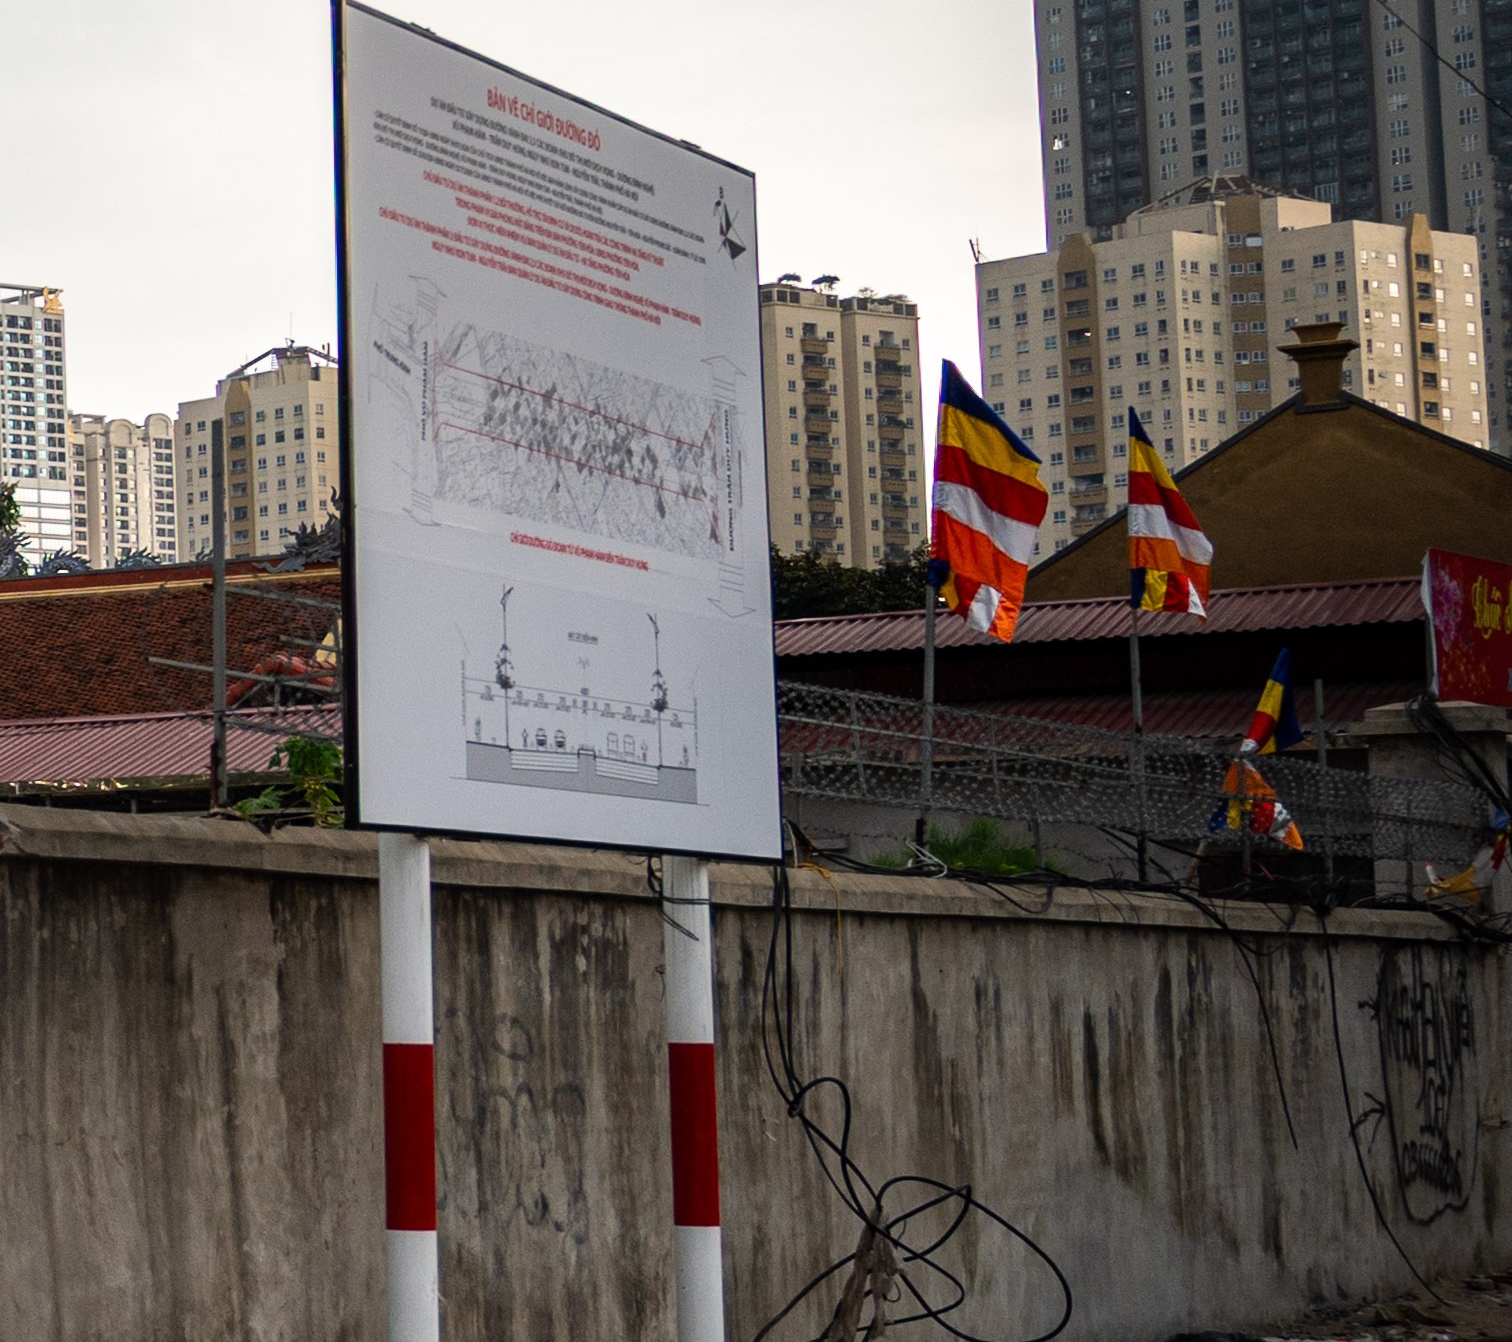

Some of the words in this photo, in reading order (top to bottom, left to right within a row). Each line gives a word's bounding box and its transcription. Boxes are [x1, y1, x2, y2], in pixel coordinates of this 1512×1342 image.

[487, 86, 506, 112] BẢN
[521, 102, 535, 124] CHỈ
[588, 128, 601, 151] ĐỎ
